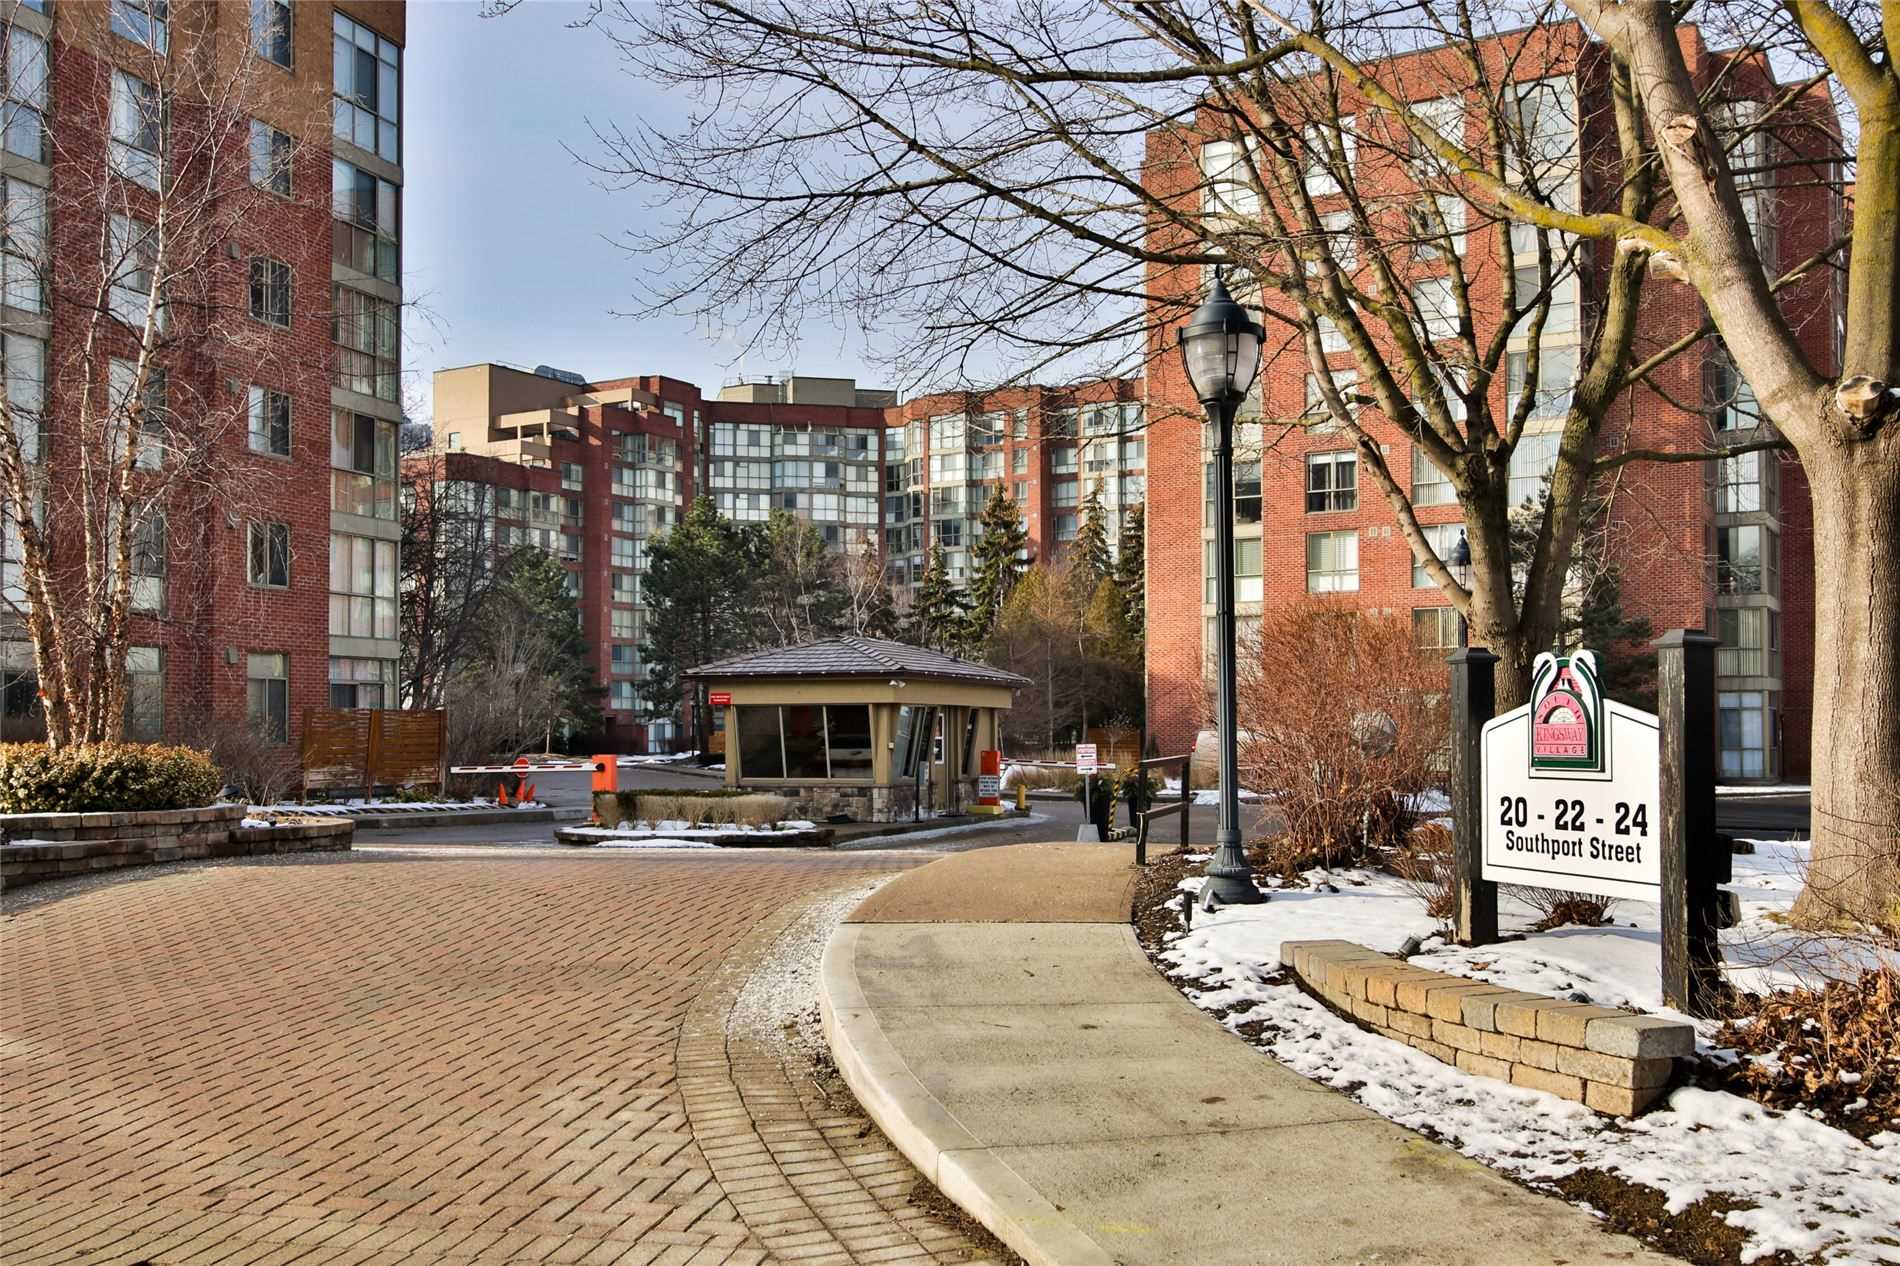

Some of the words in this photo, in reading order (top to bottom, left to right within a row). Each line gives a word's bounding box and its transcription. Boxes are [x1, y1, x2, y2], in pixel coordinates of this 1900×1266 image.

[1536, 727, 1584, 742] KINGSWAY
[1536, 745, 1585, 754] VILLAGE
[1500, 796, 1528, 828] 20
[1555, 799, 1585, 832] 22
[1615, 802, 1648, 837] 24
[1506, 830, 1583, 860] Southport
[1590, 837, 1642, 864] Street
